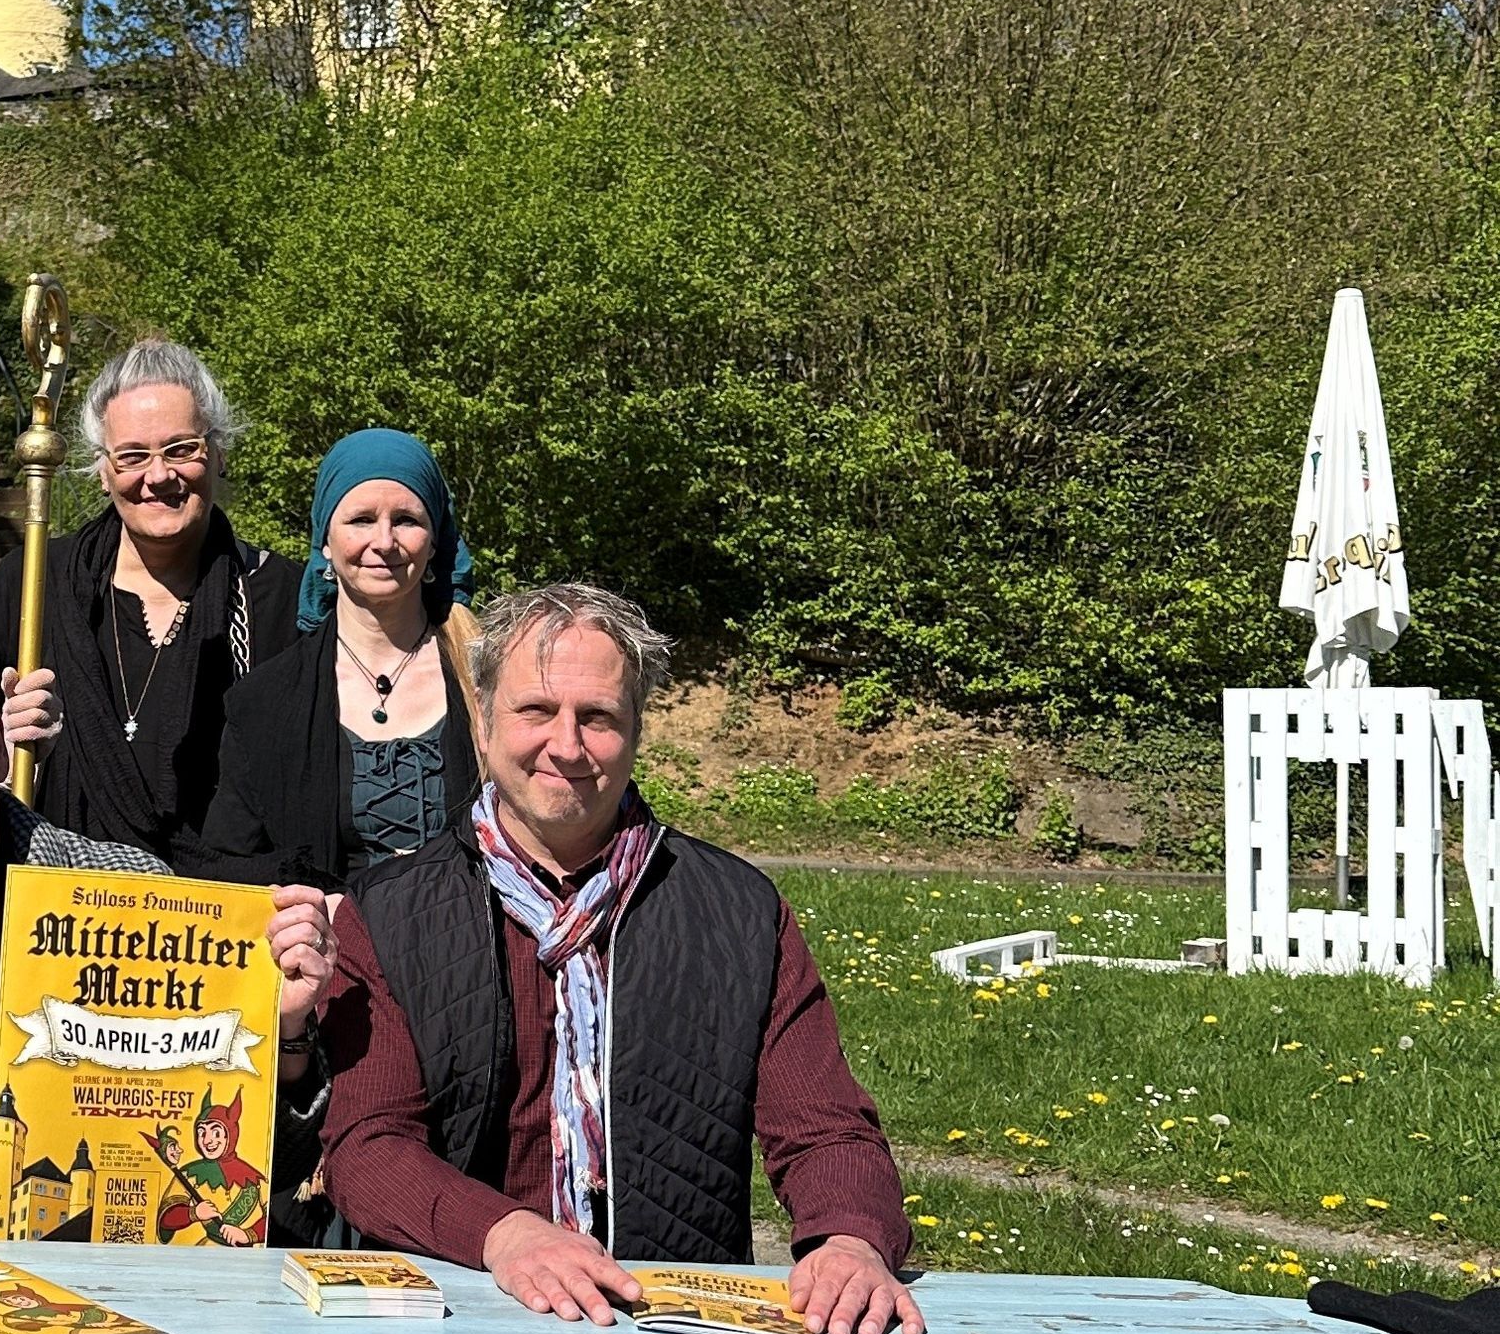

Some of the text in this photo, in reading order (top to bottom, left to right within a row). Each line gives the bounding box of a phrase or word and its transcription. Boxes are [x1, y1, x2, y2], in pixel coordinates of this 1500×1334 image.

[71, 886, 223, 919] Schloss Homburg
[27, 911, 256, 970] Mittelalter
[71, 962, 205, 1012] Markt
[73, 1086, 195, 1109] WALPURGIS-FEST
[104, 1191, 148, 1207] TICKETS
[106, 1177, 147, 1193] ONLINE
